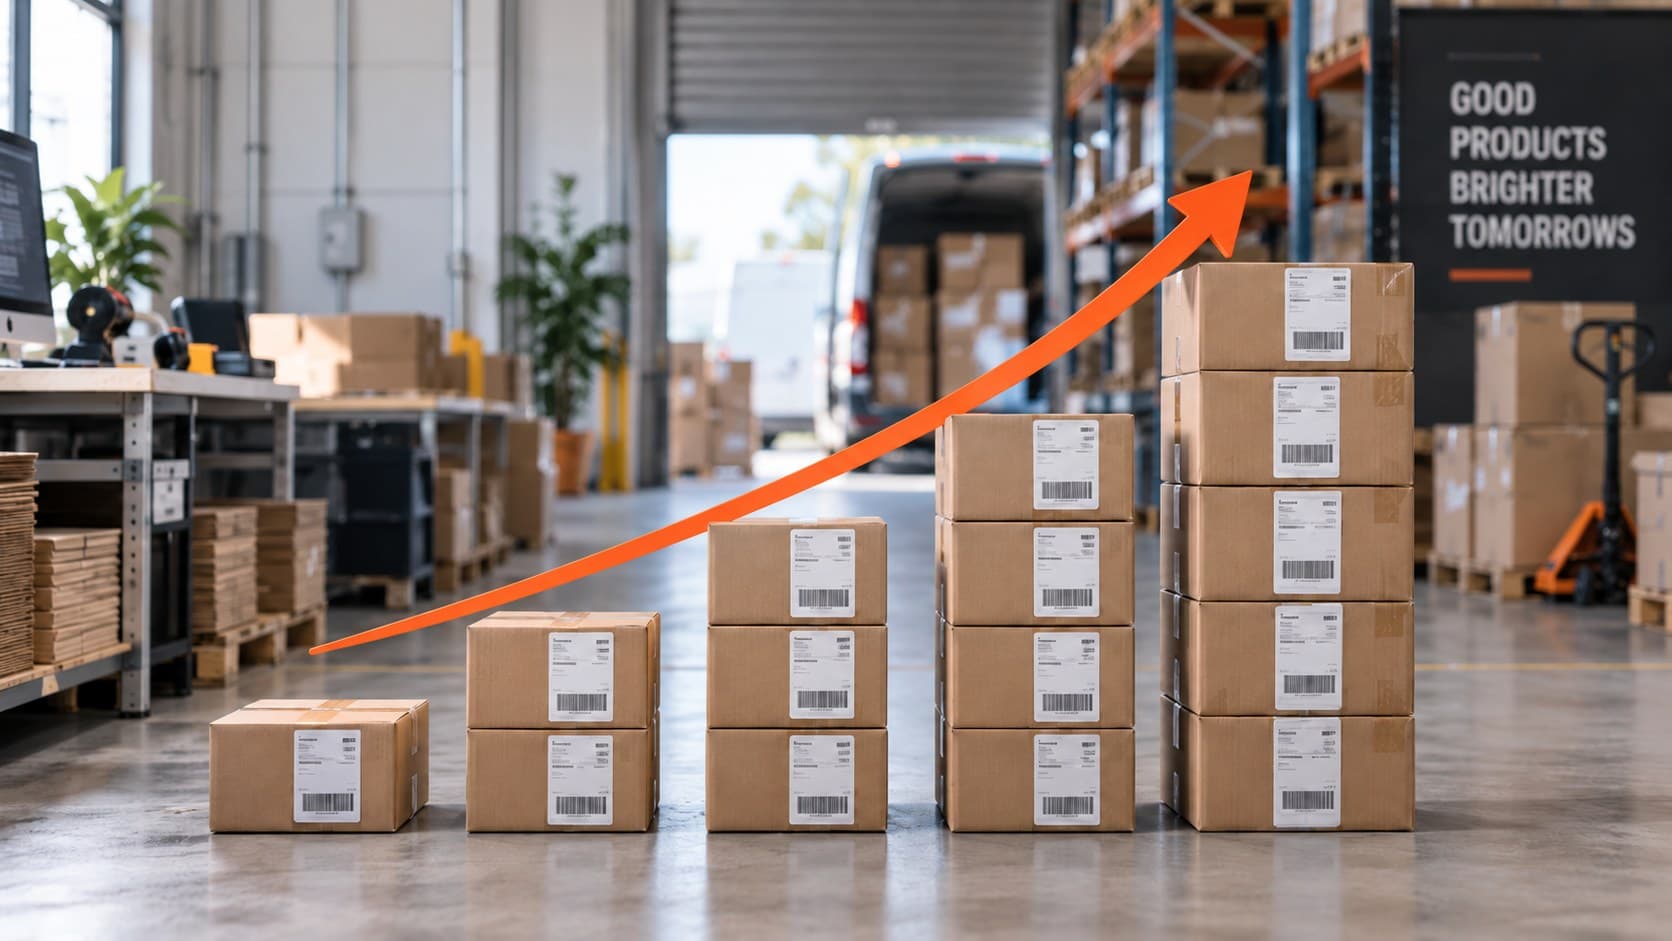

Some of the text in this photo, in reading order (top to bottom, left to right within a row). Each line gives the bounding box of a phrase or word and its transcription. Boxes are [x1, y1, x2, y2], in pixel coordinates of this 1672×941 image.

[1450, 81, 1536, 115] GOOD
[1450, 126, 1607, 160] PRODUCTS
[1450, 170, 1594, 205] BRIGHTER
[1449, 214, 1636, 249] TOMORROWS
